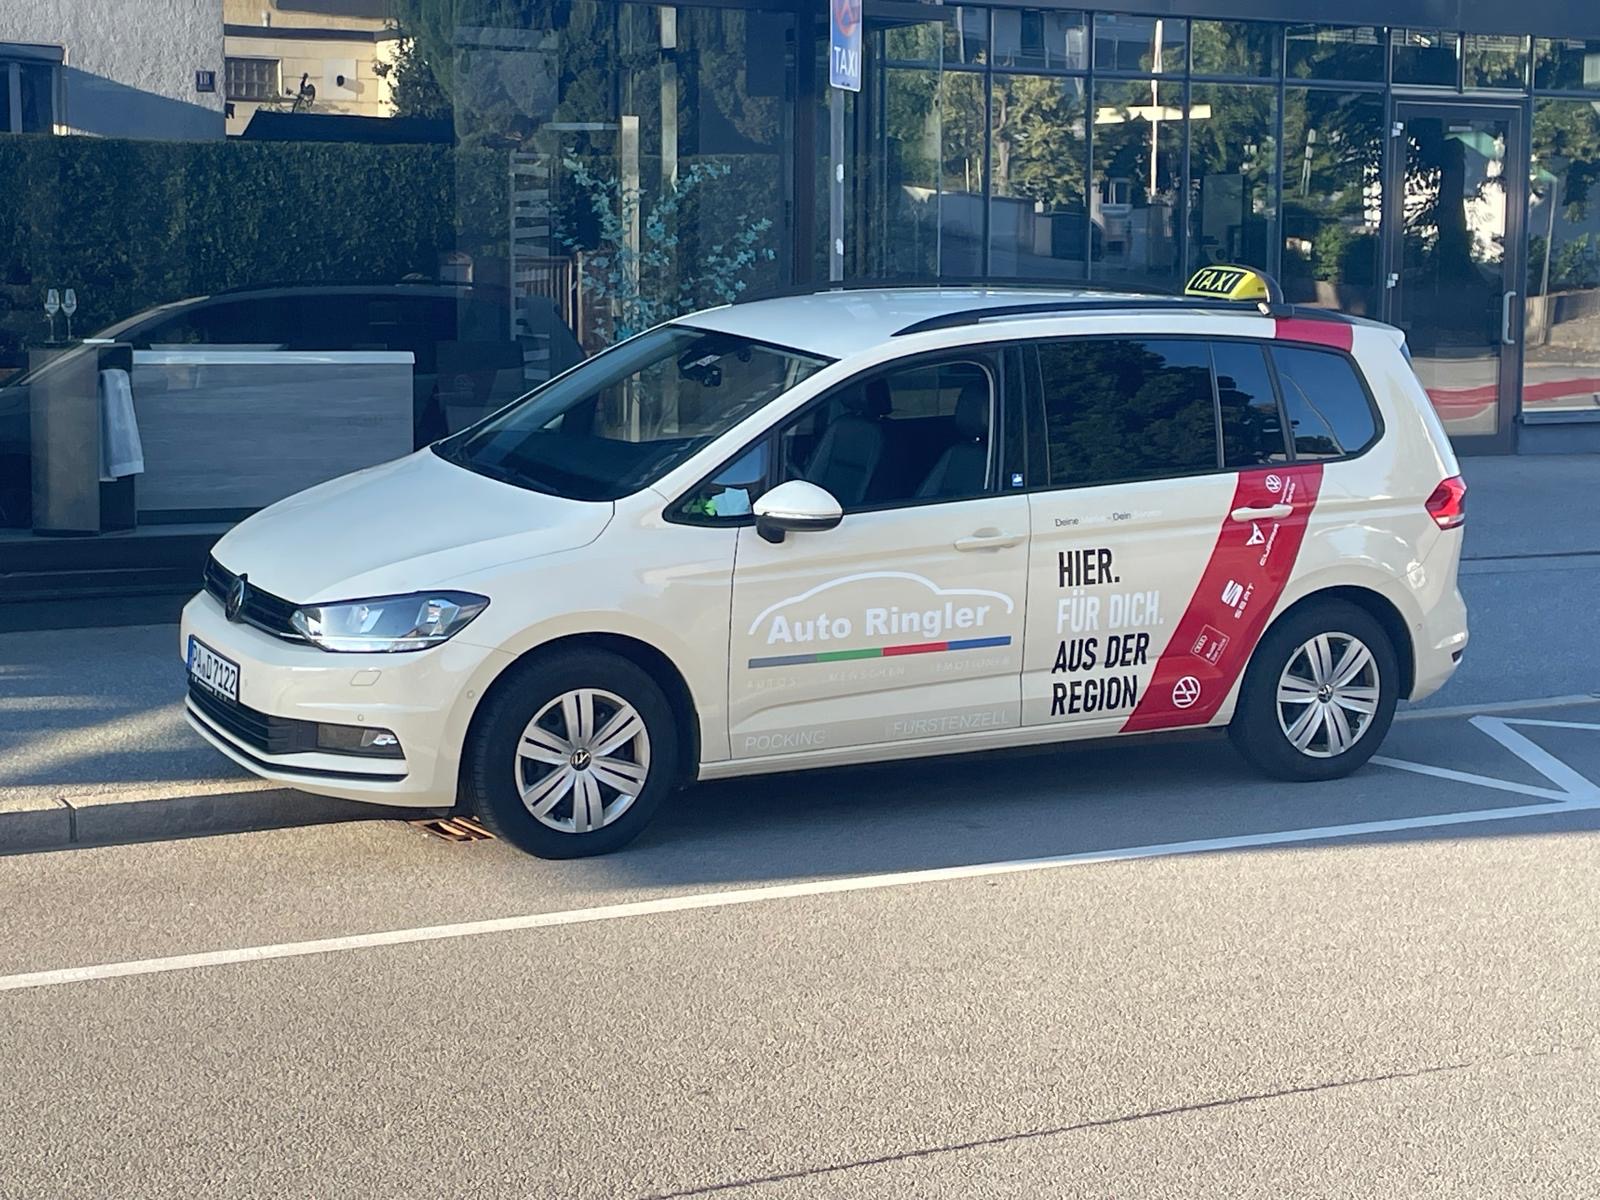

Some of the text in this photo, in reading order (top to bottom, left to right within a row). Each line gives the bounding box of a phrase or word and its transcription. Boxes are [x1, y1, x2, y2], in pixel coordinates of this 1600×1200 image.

[834, 46, 858, 77] TAXI
[1194, 270, 1240, 292] TAXI
[1055, 518, 1080, 527] Deine
[1112, 512, 1132, 521] Dein
[1260, 523, 1280, 567] CUPRA
[1058, 548, 1120, 588] HIER.
[1056, 589, 1164, 635] FÜR DICH.
[1234, 582, 1254, 619] SEAT
[767, 602, 991, 645] Auto Ringler
[1051, 632, 1150, 674] AUS DER
[744, 730, 827, 751] POCKING
